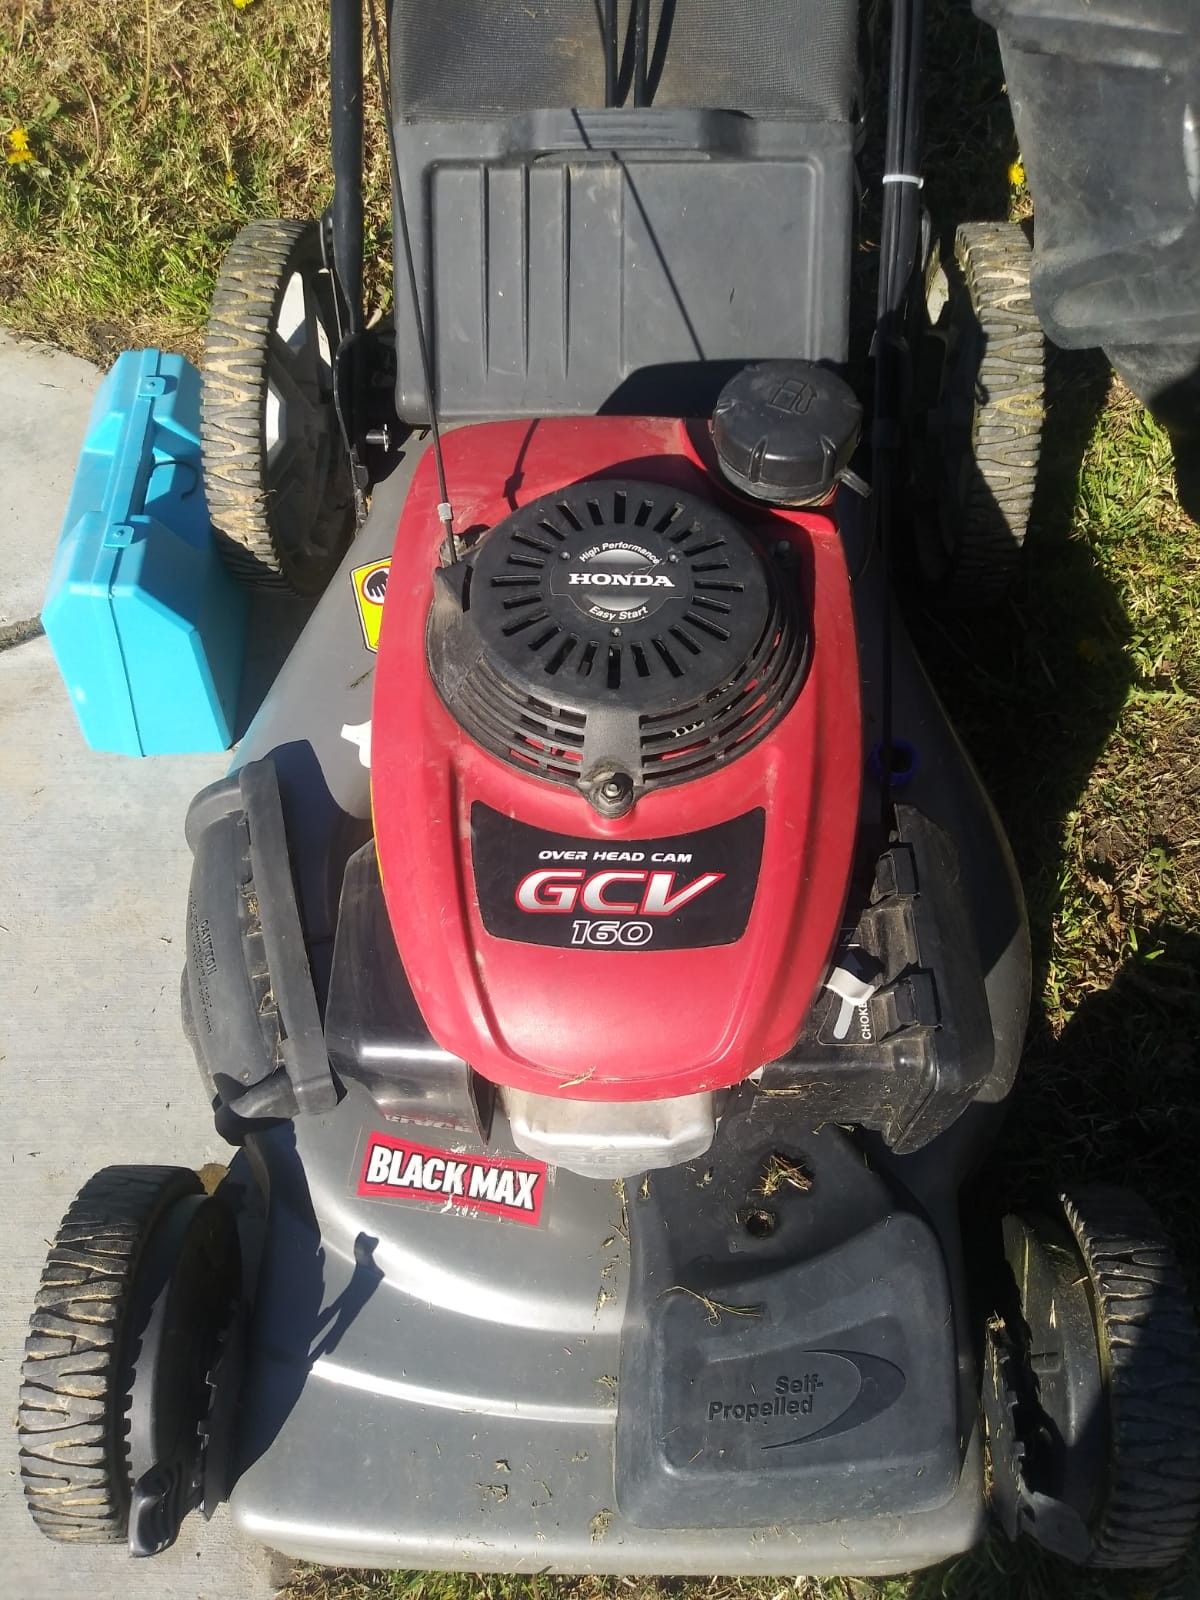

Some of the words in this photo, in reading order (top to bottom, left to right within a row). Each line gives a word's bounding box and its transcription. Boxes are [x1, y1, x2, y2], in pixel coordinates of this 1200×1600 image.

[579, 547, 600, 562] High
[602, 541, 662, 564] Performance
[568, 573, 675, 587] HONDA
[589, 605, 616, 621] Easy
[618, 606, 648, 620] Start
[538, 850, 588, 861] OVER
[592, 851, 645, 862] HEAD
[651, 852, 693, 863] CAM
[515, 868, 727, 916] GCV
[571, 920, 653, 946] 160
[201, 919, 217, 976] CAUTION
[366, 1144, 470, 1197] BLACK
[467, 1164, 541, 1212] MAX
[775, 1373, 824, 1395] Self-
[708, 1395, 813, 1422] Propelled
